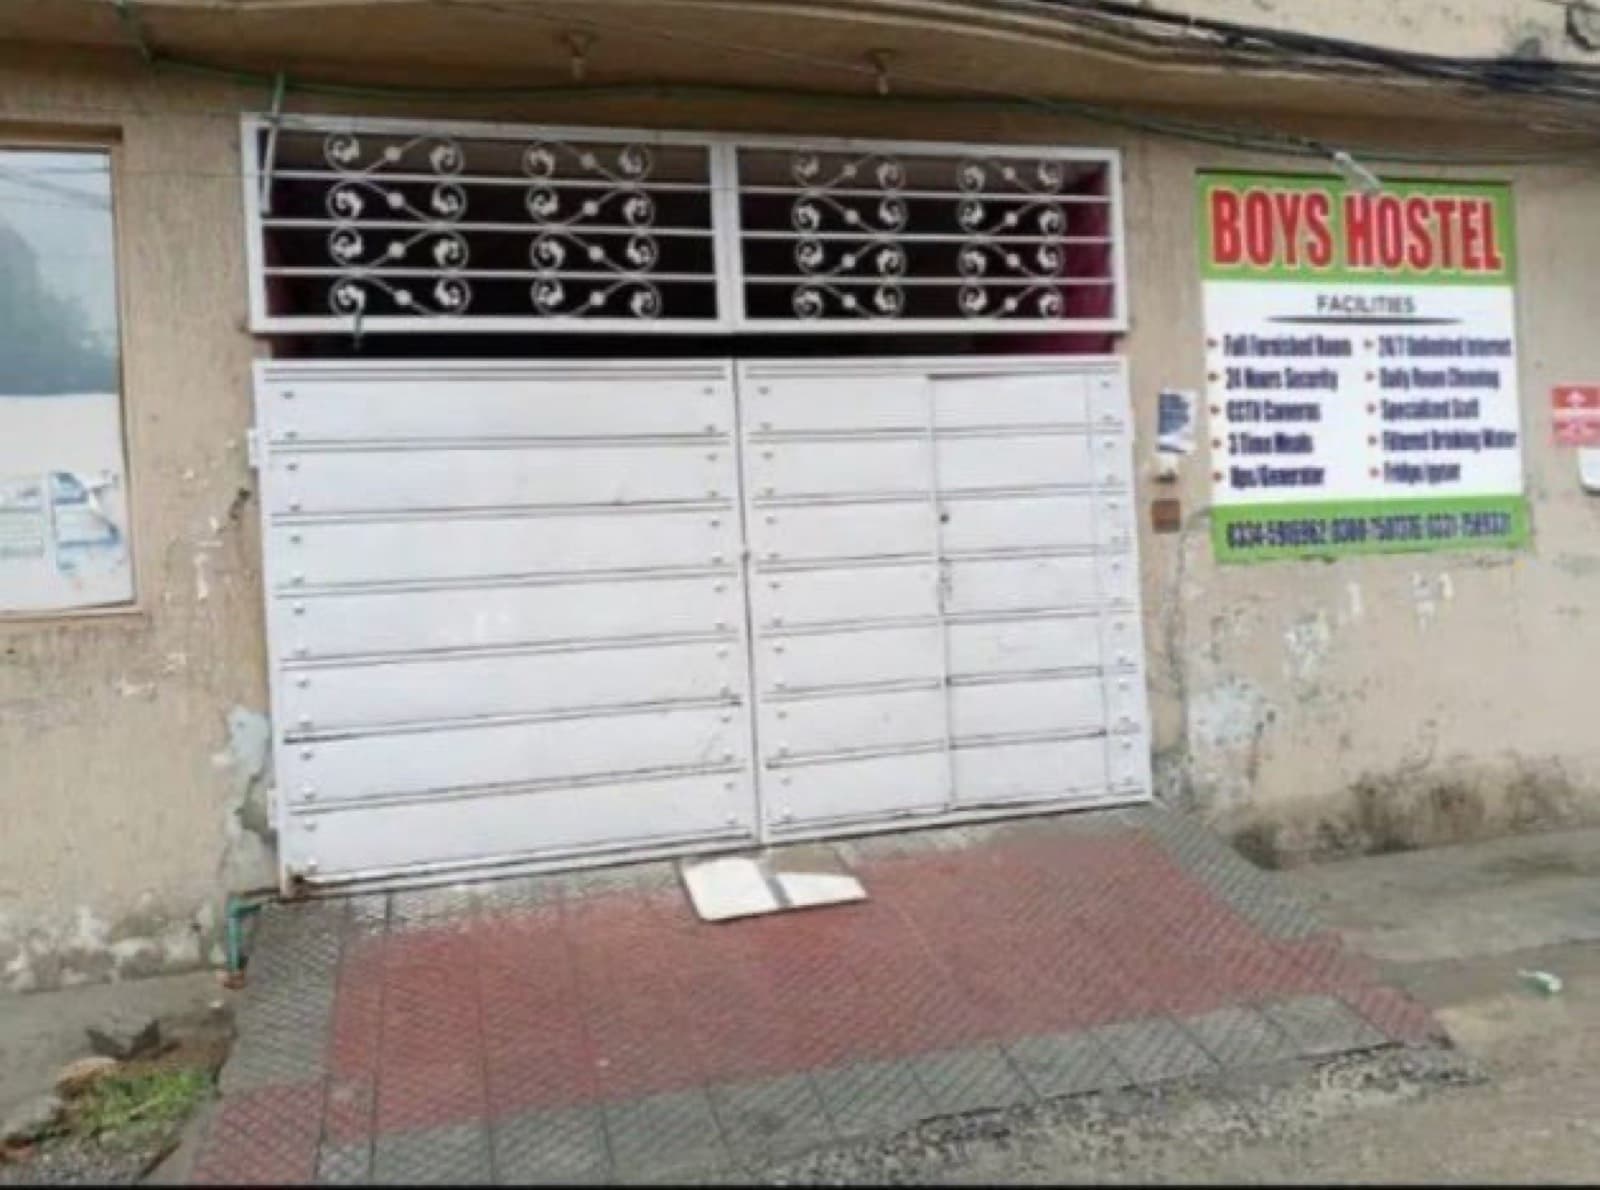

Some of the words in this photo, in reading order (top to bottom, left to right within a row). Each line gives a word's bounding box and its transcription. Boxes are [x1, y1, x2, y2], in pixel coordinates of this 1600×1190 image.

[1210, 187, 1333, 268] BOYS
[1344, 191, 1503, 272] HOSTEL
[1315, 295, 1417, 314] FACILITIES
[1284, 367, 1339, 391] Security
[1226, 400, 1261, 422] CCTV
